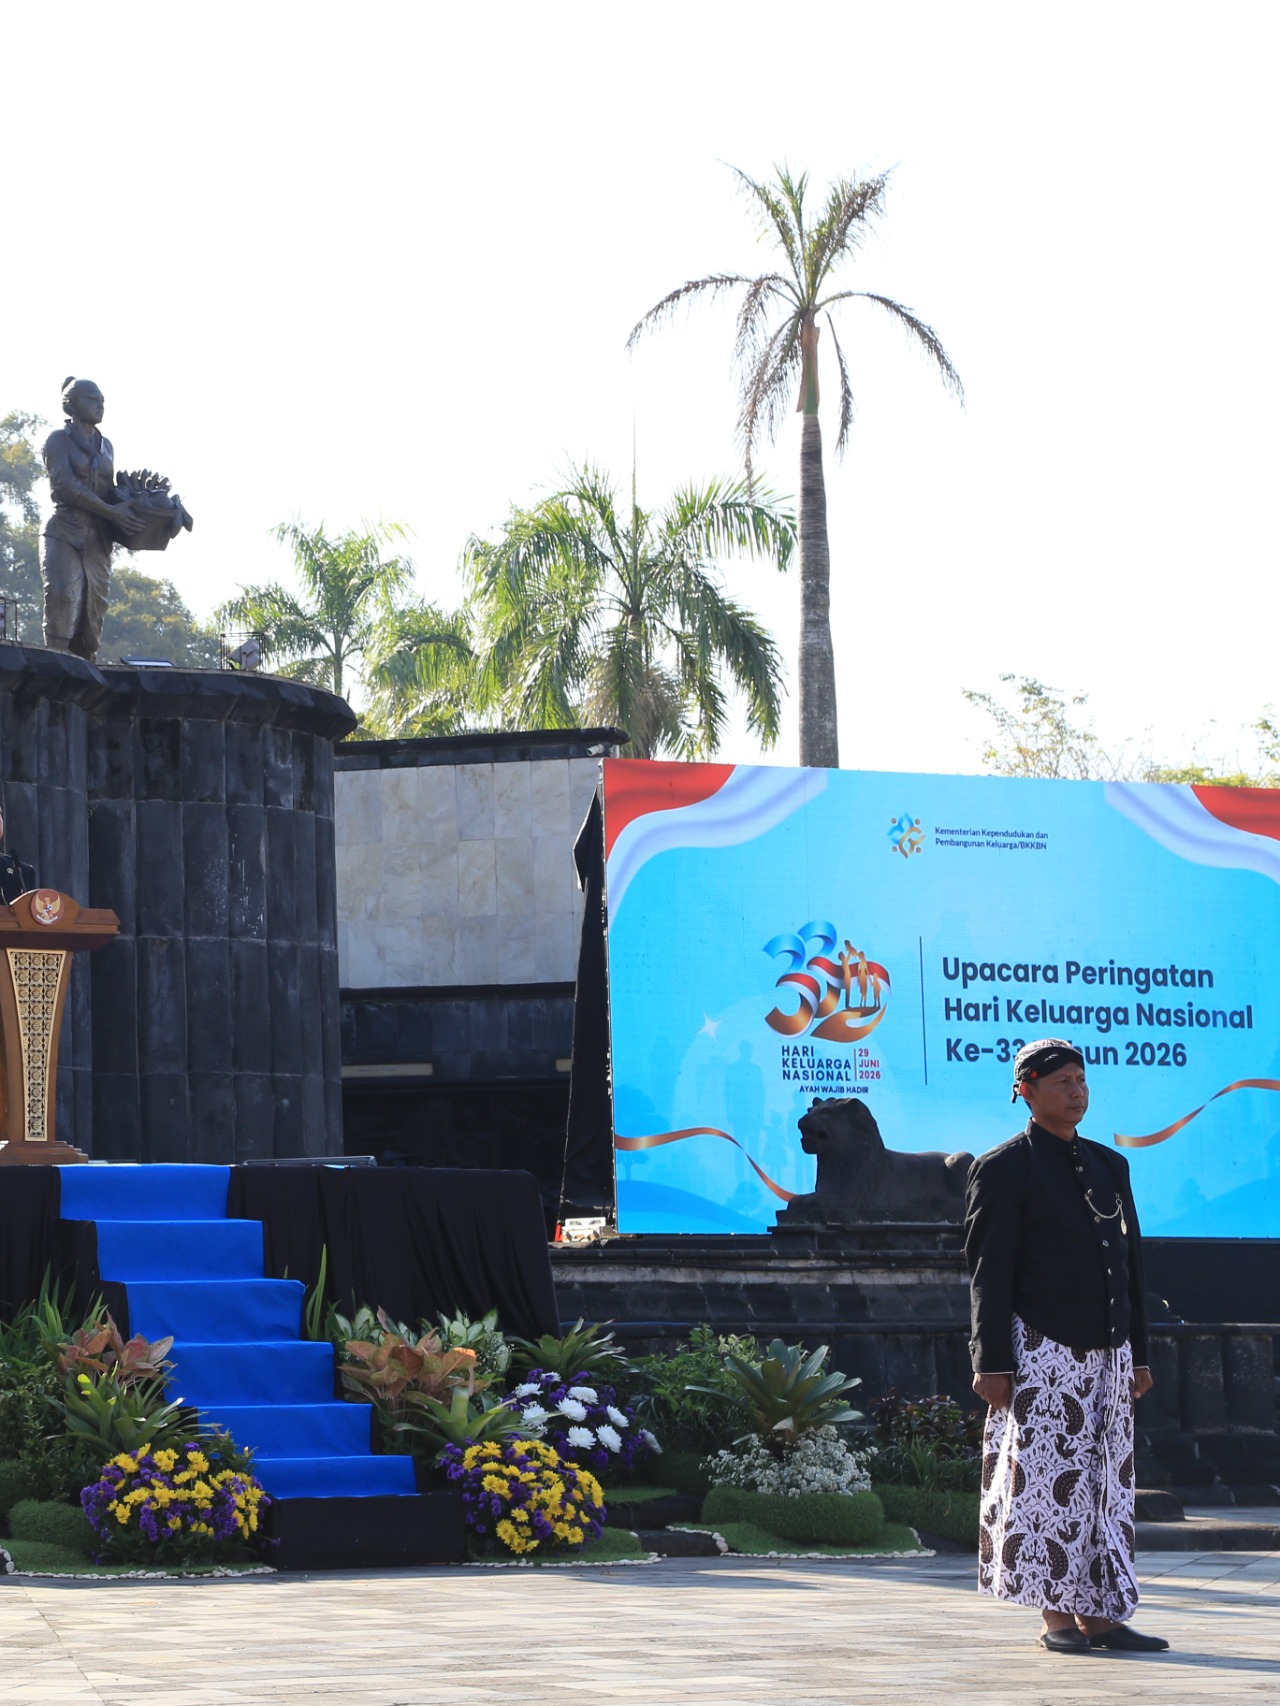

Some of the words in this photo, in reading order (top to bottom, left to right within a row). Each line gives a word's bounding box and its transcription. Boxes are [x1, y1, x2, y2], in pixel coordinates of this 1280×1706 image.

[935, 827, 981, 836] Kementerian
[982, 829, 1035, 839] Kependudukan
[1036, 831, 1048, 839] dan
[936, 838, 985, 848] Pembangunan
[986, 840, 1047, 850] Keluarga/BKKBN
[942, 957, 1059, 989] Upacara
[1065, 959, 1214, 994] Peringatan
[944, 996, 999, 1022] Hari
[1007, 999, 1129, 1033] Keluarga
[1136, 1002, 1253, 1029] Nasional
[781, 1045, 814, 1057] HARI
[858, 1048, 869, 1057] 29
[1125, 1041, 1187, 1067] 2026
[782, 1058, 851, 1070] KELUARGA
[858, 1059, 880, 1068] JUNI
[782, 1069, 851, 1081] NASIONAL
[859, 1071, 881, 1080] 2026
[799, 1085, 820, 1093] AYAH
[820, 1086, 845, 1094] WAJIB
[846, 1086, 869, 1094] HADIR
